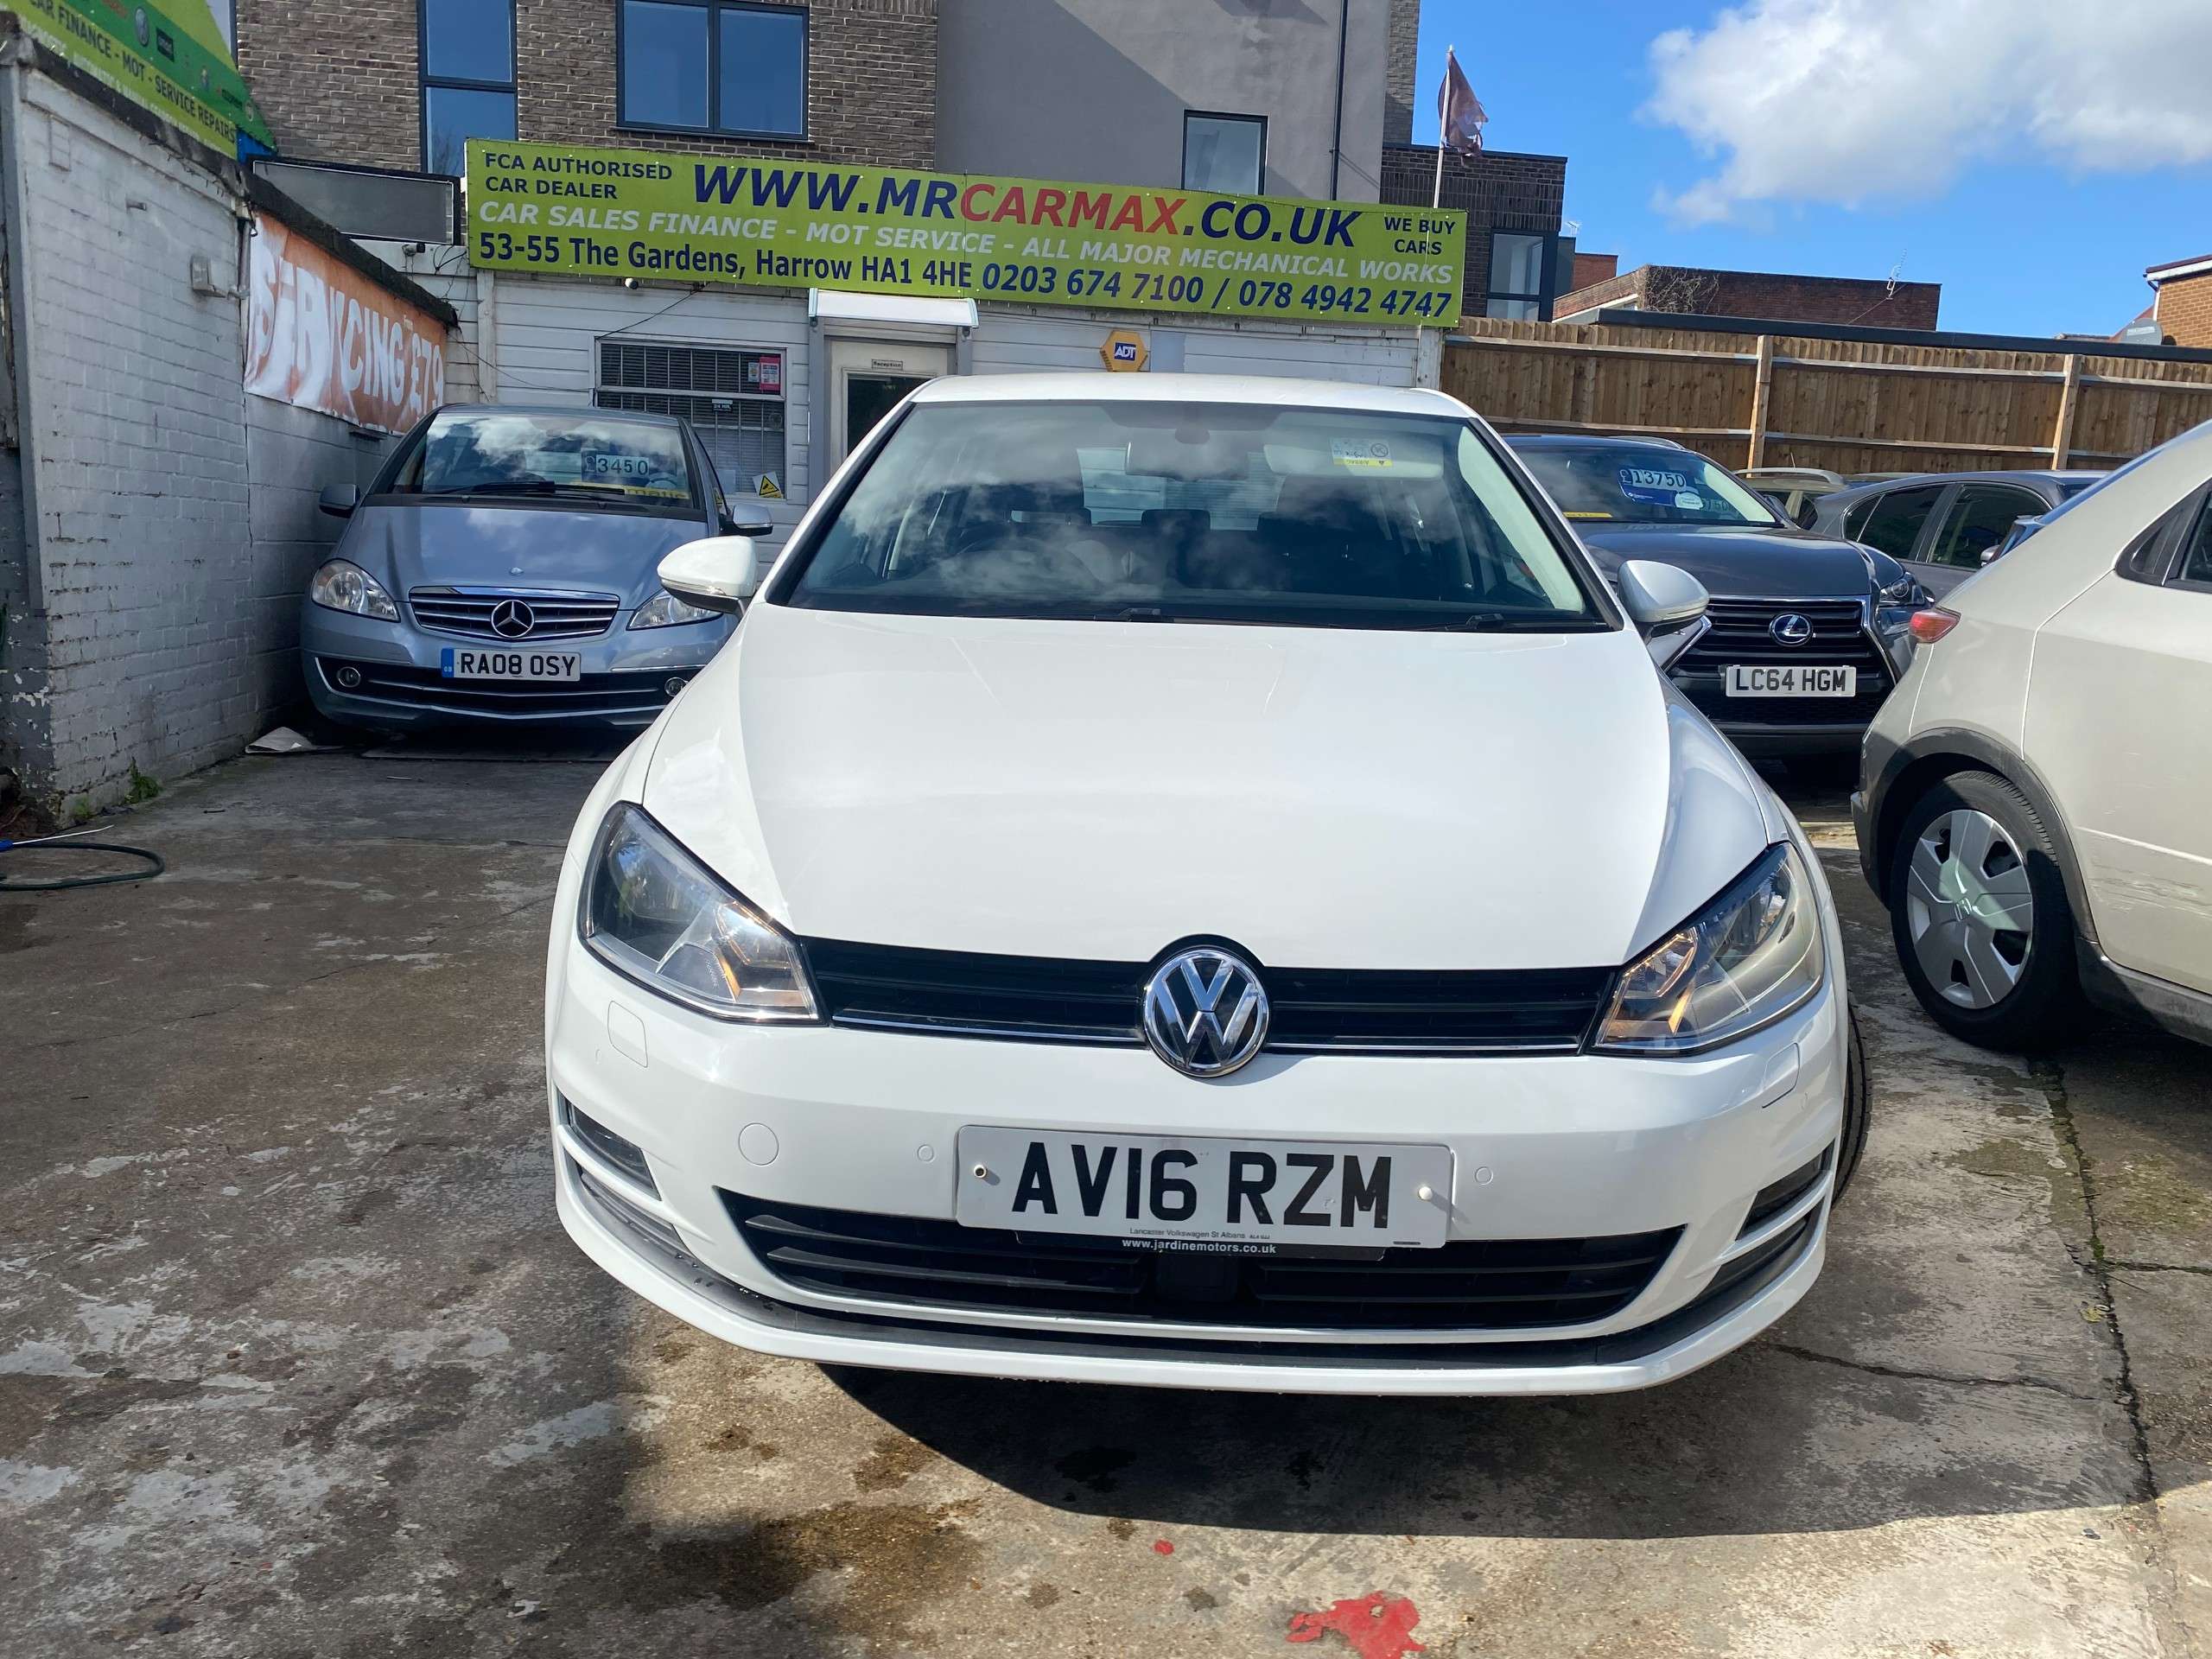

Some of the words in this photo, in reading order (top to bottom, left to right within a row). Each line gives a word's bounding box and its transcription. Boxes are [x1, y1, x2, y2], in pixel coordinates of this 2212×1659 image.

[29, 0, 54, 19] AR
[59, 6, 111, 58] FINANCE
[123, 51, 145, 82] MOT
[155, 75, 195, 118] SERVICE
[198, 106, 236, 144] REPAIRS
[485, 152, 525, 170] FCA
[532, 156, 672, 180] AUTHORISED
[486, 176, 529, 194] CAR
[537, 180, 618, 200] DEALER
[694, 163, 1363, 247] WWW.MRCARMAX.CO.UK
[1384, 216, 1413, 233] WE
[1419, 219, 1456, 235] BUY
[479, 200, 539, 225] CAR
[548, 206, 639, 231] SALES
[648, 212, 778, 239] FINANCE
[805, 221, 869, 245] MOT
[874, 226, 996, 254] SERVICE
[1021, 237, 1071, 259] ALL
[1080, 240, 1171, 266] MAJOR
[1179, 247, 1349, 278] MECHANICAL
[1359, 260, 1453, 285] WORKS
[1394, 238, 1442, 256] CARS
[480, 232, 560, 264] 53-55
[569, 238, 619, 266] The
[628, 241, 746, 280] Gardens,
[756, 249, 853, 281] Harrow
[861, 255, 912, 284] HA1
[922, 259, 972, 289] 4HE
[982, 263, 1058, 295] 0203
[1066, 269, 1122, 298] 674
[1130, 272, 1205, 303] 7100
[1211, 277, 1230, 309] /
[1238, 279, 1294, 309] 078
[1300, 284, 1372, 314] 4942
[1380, 289, 1452, 318] 4747
[1115, 345, 1137, 359] ADT
[1619, 468, 1686, 487] £13750
[461, 652, 522, 676] RA08
[531, 655, 575, 677] OSY
[1736, 668, 1795, 691] LC64
[1802, 669, 1847, 692] HGM
[1012, 1141, 1198, 1222] AV16
[1227, 1150, 1392, 1230] RZM
[1129, 1227, 1165, 1236] Lancaster
[1166, 1229, 1210, 1239] Volkswagen
[1122, 1238, 1277, 1254] www.jardinemotors.co.uk
